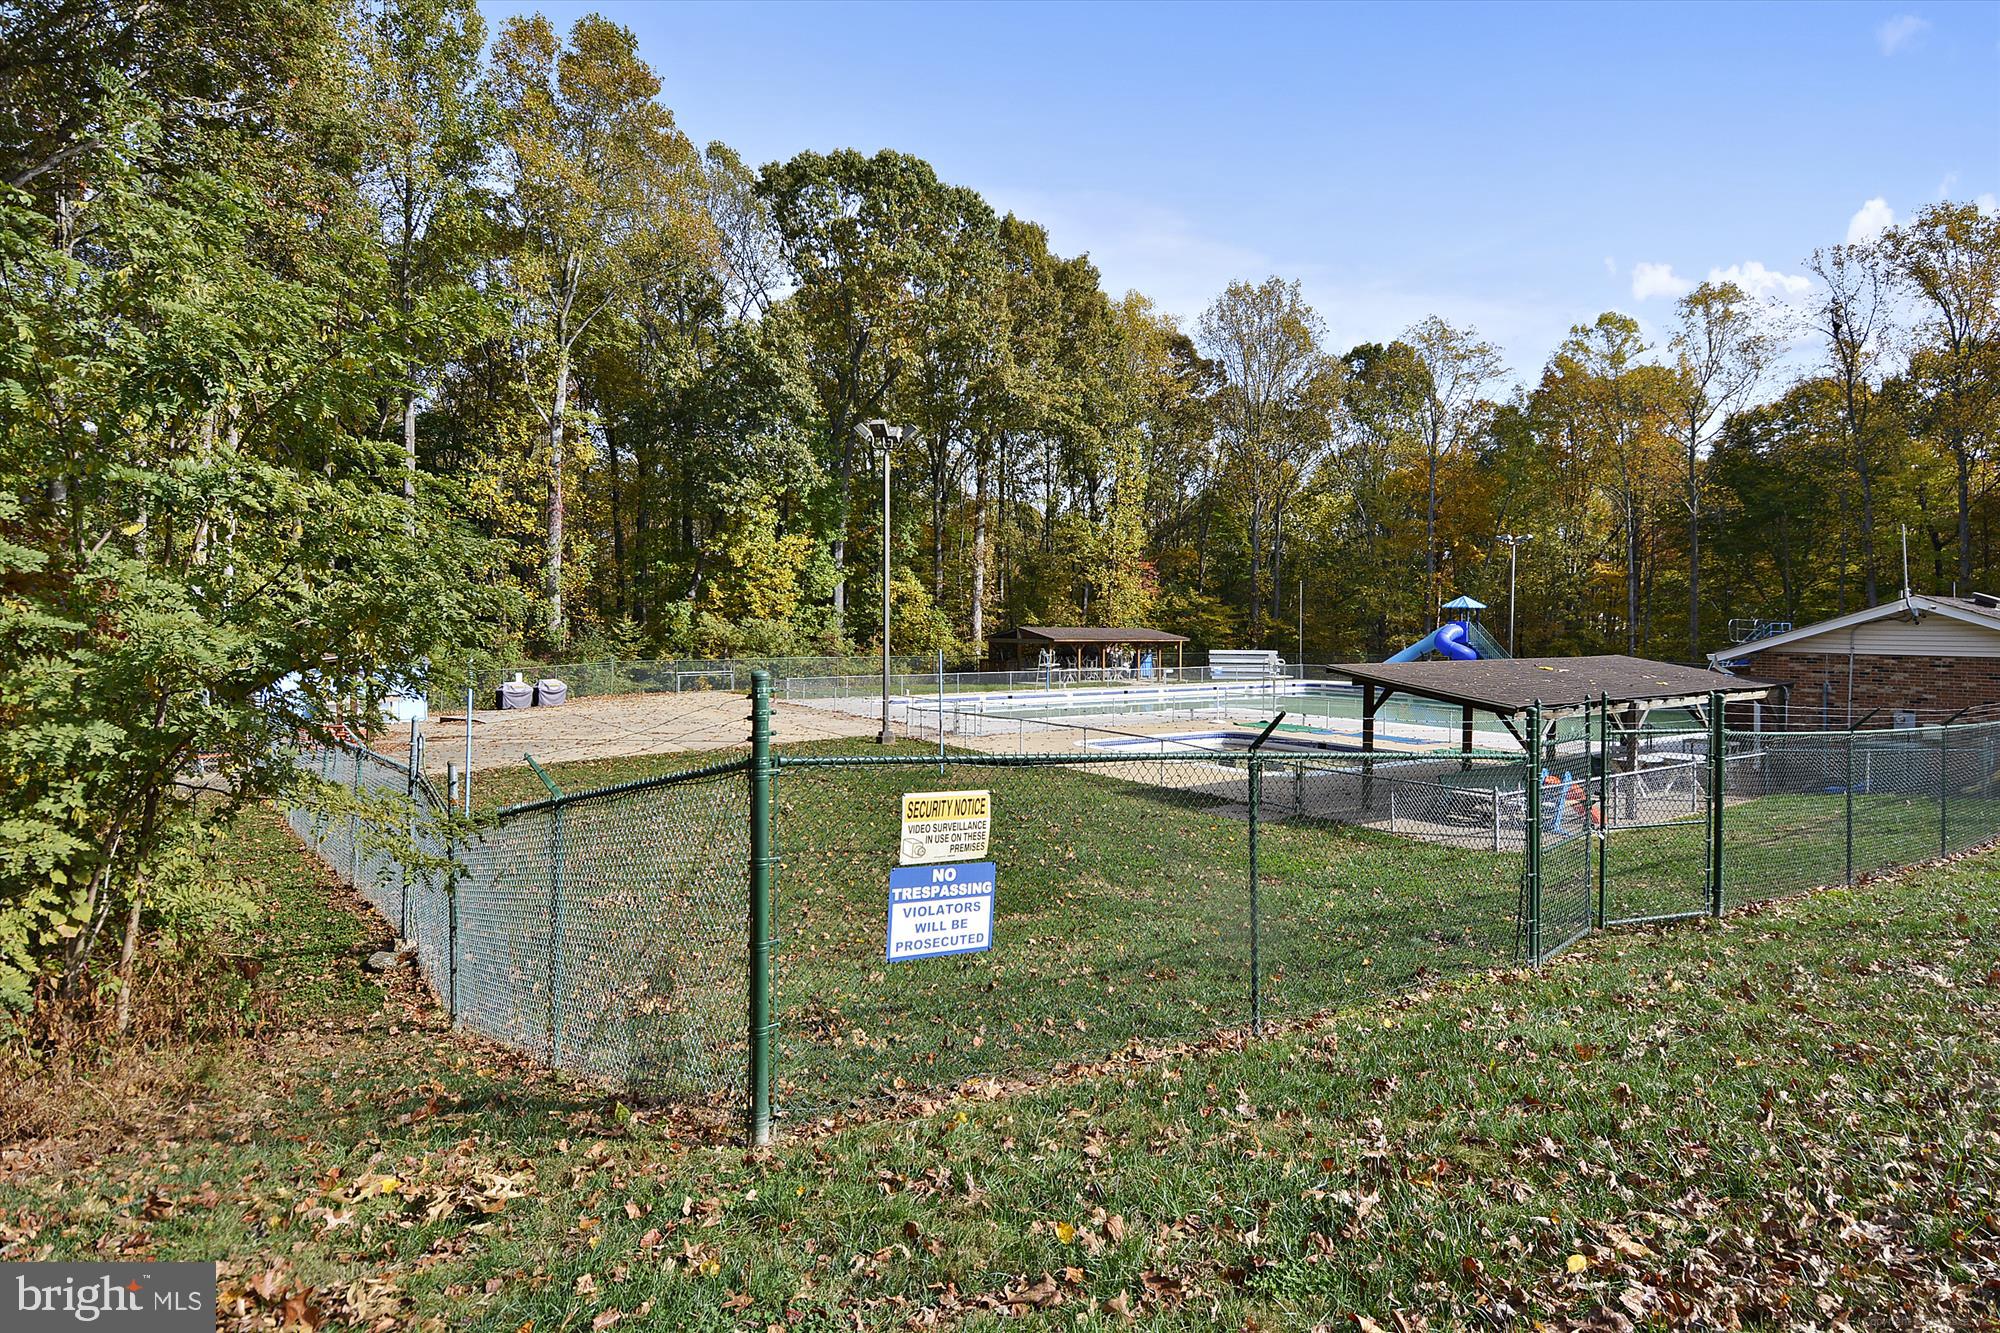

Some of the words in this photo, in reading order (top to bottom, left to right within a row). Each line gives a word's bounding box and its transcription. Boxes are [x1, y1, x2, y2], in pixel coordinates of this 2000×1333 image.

[907, 800, 953, 819] SECURITY
[954, 798, 986, 816] NOTICE
[908, 824, 931, 834] VIDEO
[932, 820, 987, 833] SURVEILLANCE
[925, 835, 933, 844] IN
[934, 833, 949, 843] USE
[951, 833, 962, 842] ON
[963, 831, 986, 841] THESE
[949, 842, 985, 853] PREMISES
[932, 867, 957, 883] NO
[892, 881, 992, 901] TRESPASSING
[903, 901, 981, 918] VIOLATORS
[915, 921, 946, 933] WILL
[951, 919, 968, 930] BE
[895, 933, 984, 952] PROSECUTED
